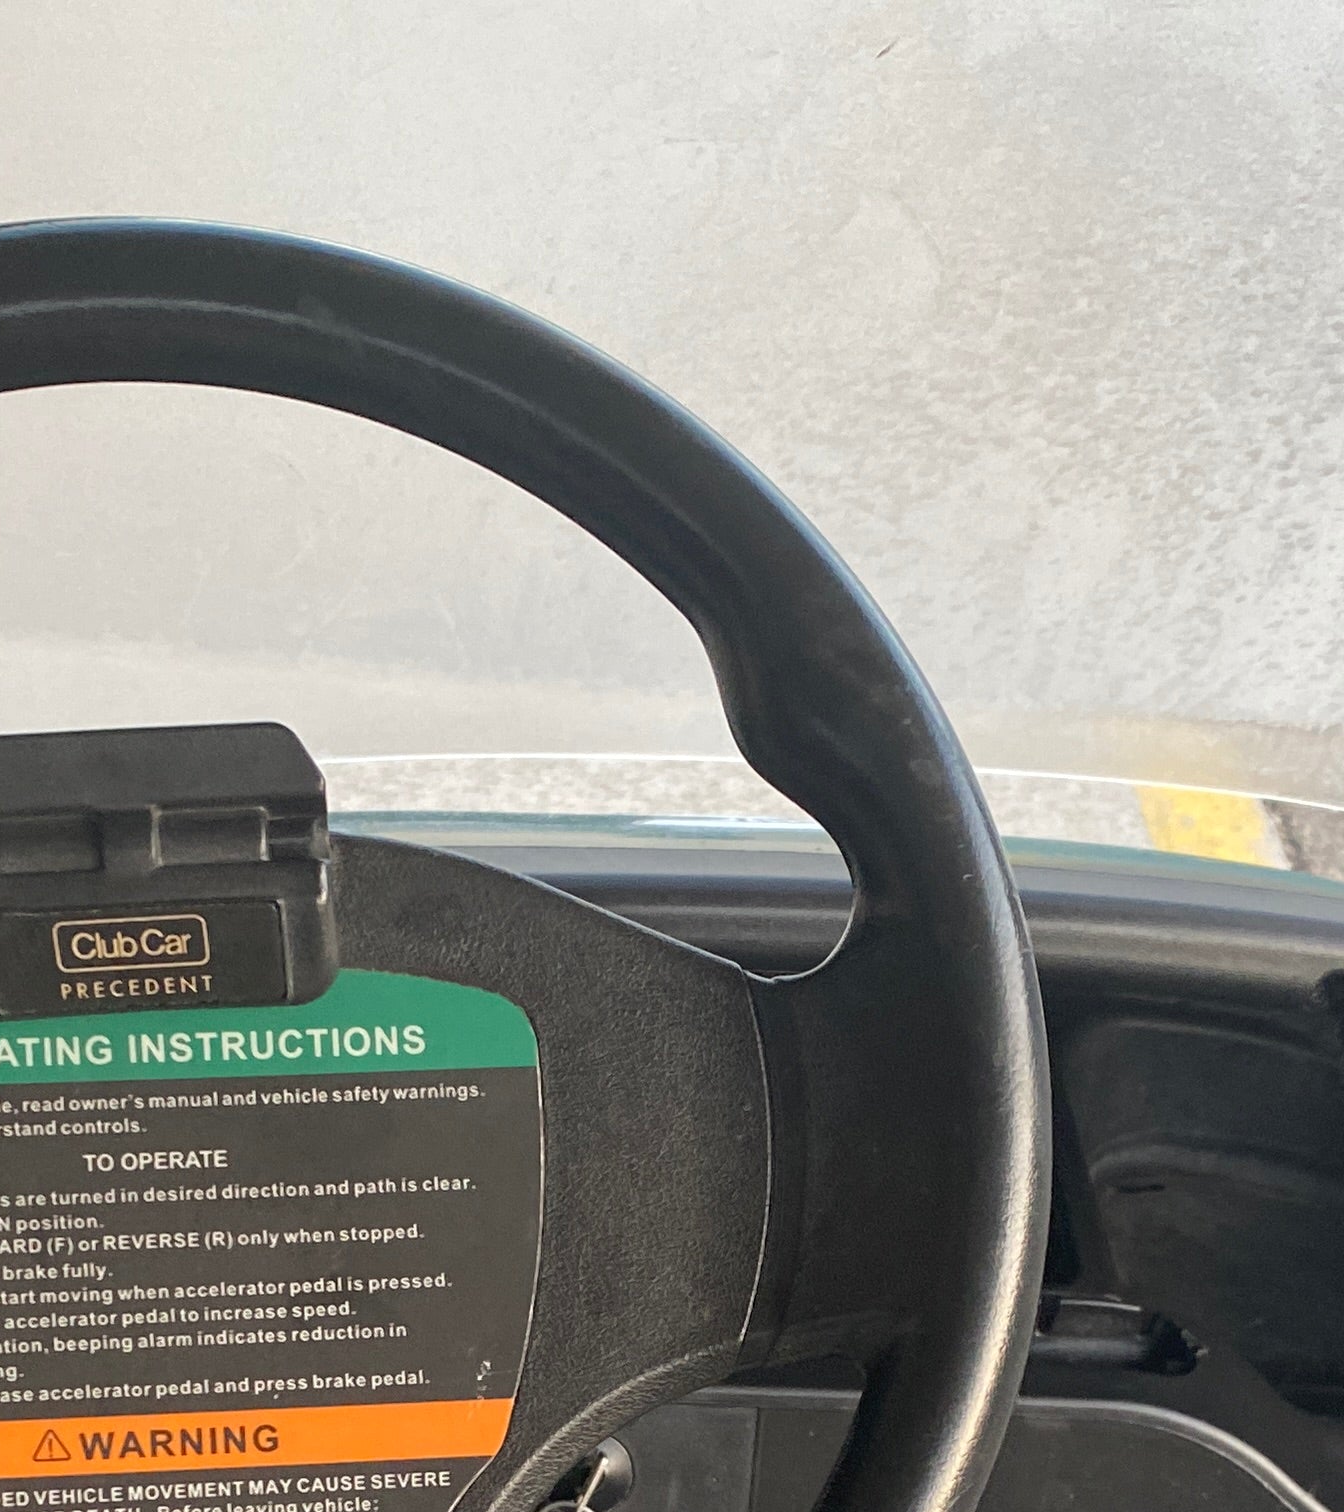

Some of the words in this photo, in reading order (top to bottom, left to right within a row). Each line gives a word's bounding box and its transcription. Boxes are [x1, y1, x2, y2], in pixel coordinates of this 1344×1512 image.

[61, 975, 212, 1000] PRECEDENT
[128, 1025, 425, 1063] INSTRUCTIONS
[22, 1096, 64, 1112] read
[69, 1094, 144, 1111] owner's
[149, 1091, 218, 1108] manual
[222, 1090, 257, 1106] and
[260, 1088, 328, 1104] vehicle
[332, 1086, 389, 1104] safety
[393, 1083, 485, 1101] warnings.
[61, 1118, 147, 1135] controls.
[82, 1154, 114, 1172] TO
[121, 1150, 228, 1171] OPERATE
[15, 1194, 46, 1206] are
[50, 1188, 116, 1205] turned
[121, 1188, 138, 1203] in
[143, 1185, 217, 1202] desired
[222, 1182, 310, 1199] direction
[314, 1180, 349, 1195] and
[354, 1178, 396, 1198] path
[401, 1177, 417, 1192] is
[422, 1176, 476, 1191] clear.
[16, 1215, 104, 1234] position.
[47, 1237, 73, 1256] (F)
[78, 1240, 99, 1251] or
[103, 1232, 200, 1250] REVERSE
[205, 1231, 233, 1250] (R)
[237, 1230, 279, 1248] only
[284, 1228, 335, 1243] when
[340, 1224, 424, 1243] stopped.
[3, 1265, 58, 1280] brake
[62, 1263, 113, 1281] fully.
[40, 1287, 113, 1305] moving
[118, 1285, 169, 1300] when
[174, 1281, 285, 1298] accelerator
[290, 1277, 342, 1297] pedal
[347, 1277, 364, 1291] is
[369, 1272, 452, 1293] pressed.
[4, 1312, 117, 1329] accelerator
[122, 1308, 175, 1328] pedal
[180, 1309, 199, 1322] to
[204, 1307, 287, 1321] increase
[292, 1301, 356, 1321] speed.
[53, 1335, 133, 1354] beeping
[138, 1333, 192, 1348] alarm
[197, 1329, 287, 1345] indicates
[292, 1324, 384, 1341] reduction
[389, 1323, 407, 1337] in
[39, 1384, 152, 1401] accelerator
[156, 1379, 209, 1399] pedal
[214, 1377, 249, 1393] and
[254, 1378, 308, 1395] press
[313, 1373, 366, 1389] brake
[371, 1370, 430, 1390] pedal.
[79, 1424, 281, 1461] WARNING
[33, 1487, 123, 1505] VEHICLE
[128, 1481, 244, 1501] MOVEMENT
[249, 1479, 292, 1495] MAY
[297, 1475, 366, 1493] CAUSE
[371, 1471, 451, 1489] SEVERE
